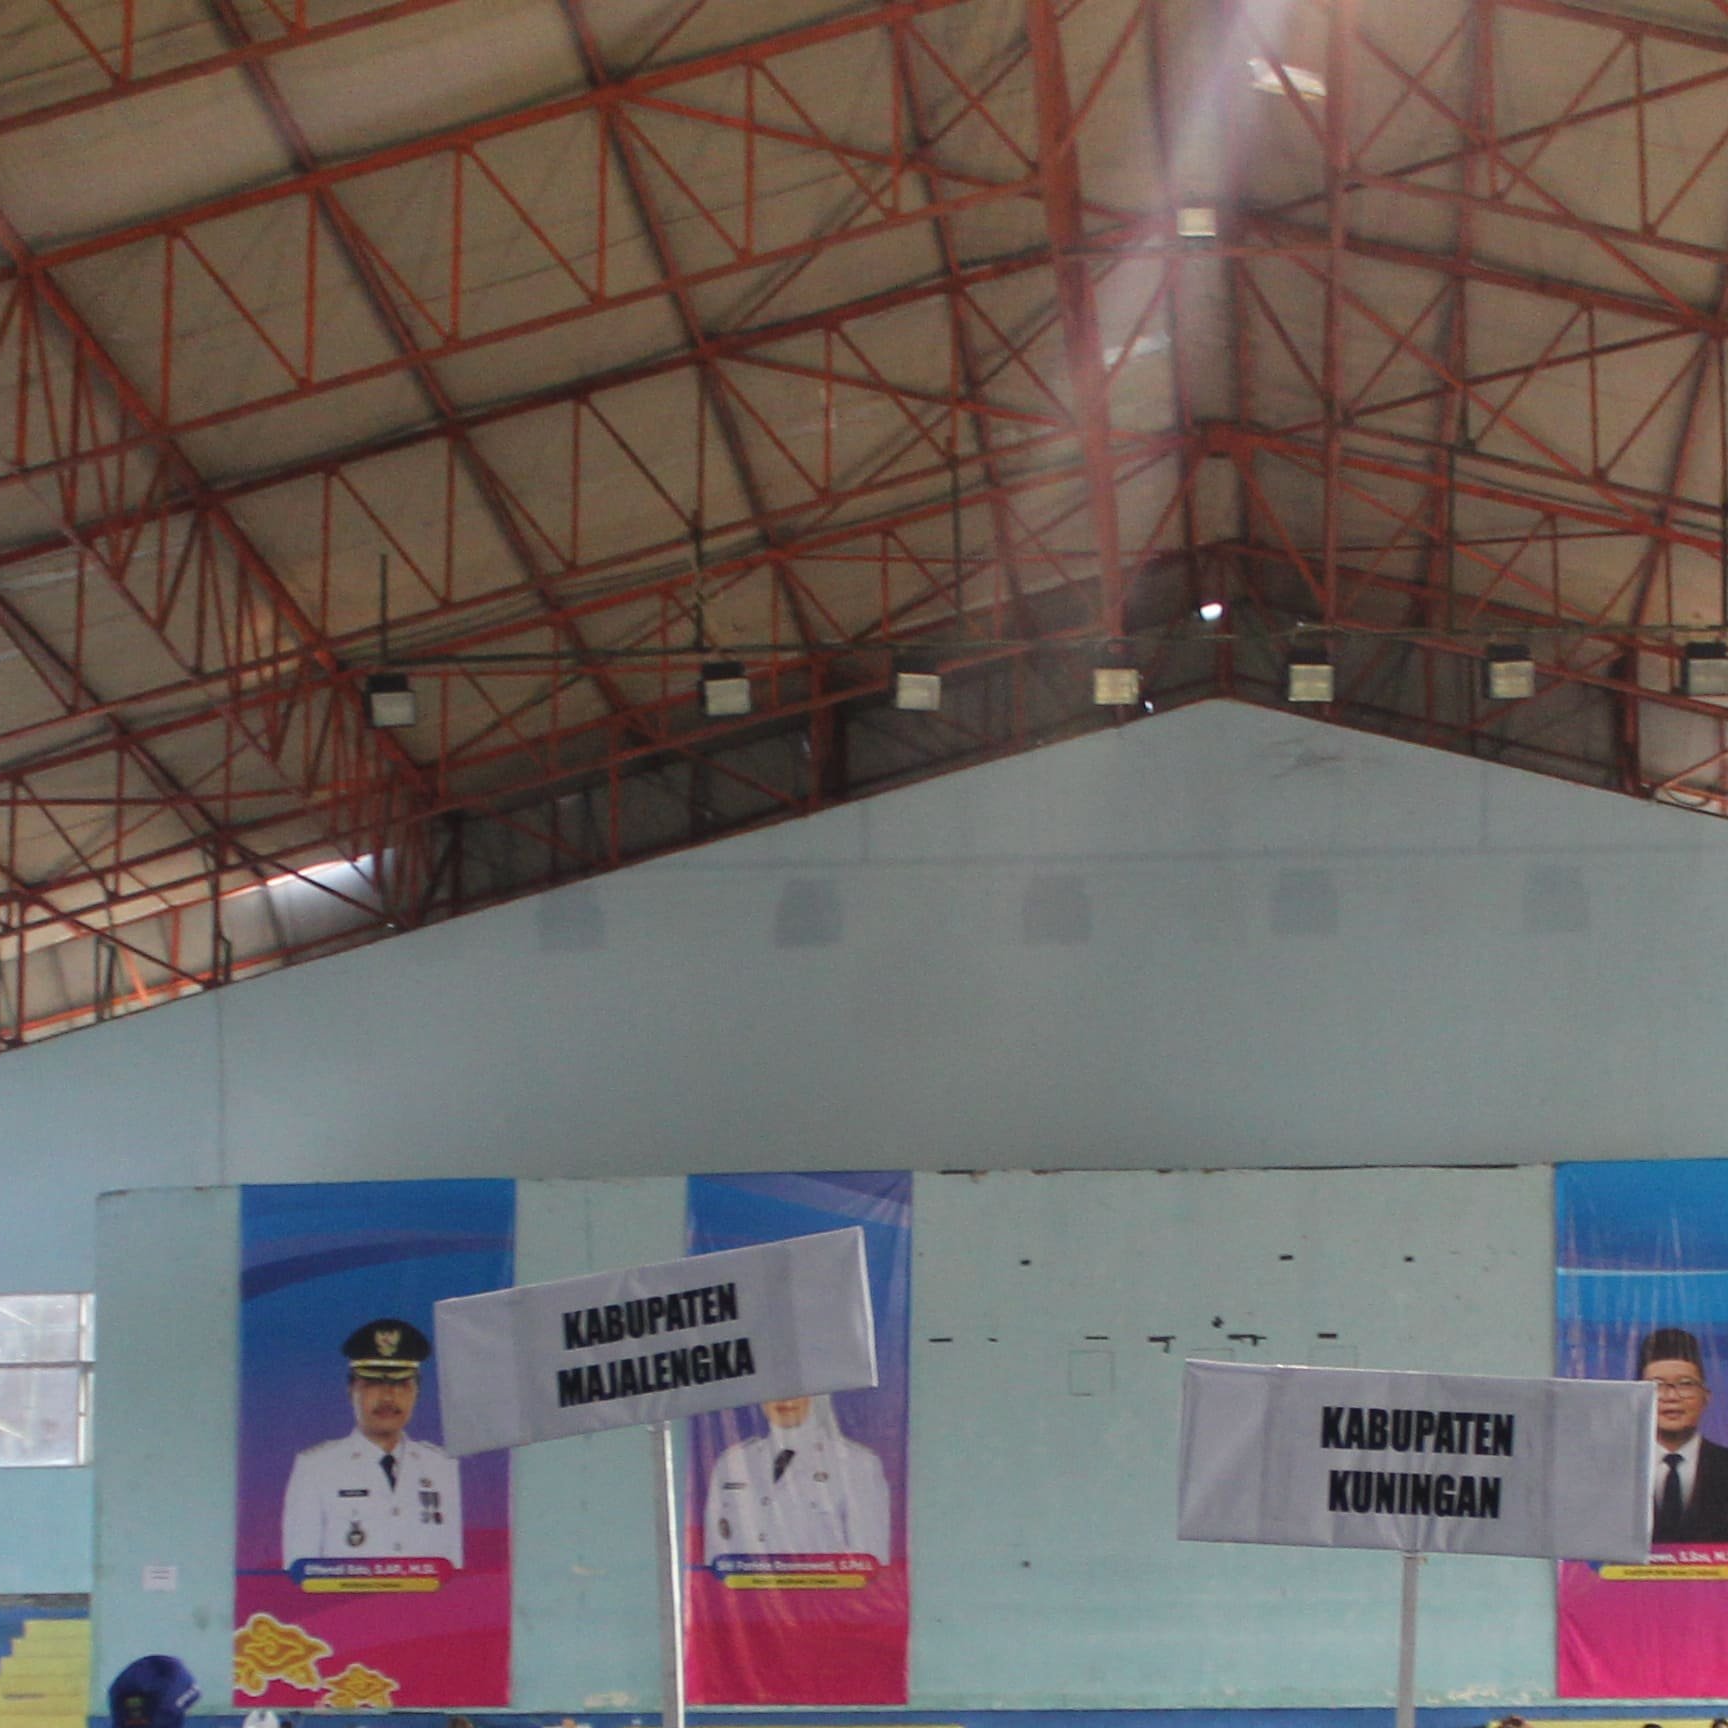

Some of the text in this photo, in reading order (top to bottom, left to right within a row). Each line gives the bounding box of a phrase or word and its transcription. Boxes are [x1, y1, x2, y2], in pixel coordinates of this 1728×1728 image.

[562, 1282, 739, 1350] KABUPATEN
[557, 1338, 756, 1408] MAJALENGKA
[1321, 1406, 1515, 1457] KABUPATEN
[1328, 1469, 1502, 1519] KUNINGAN
